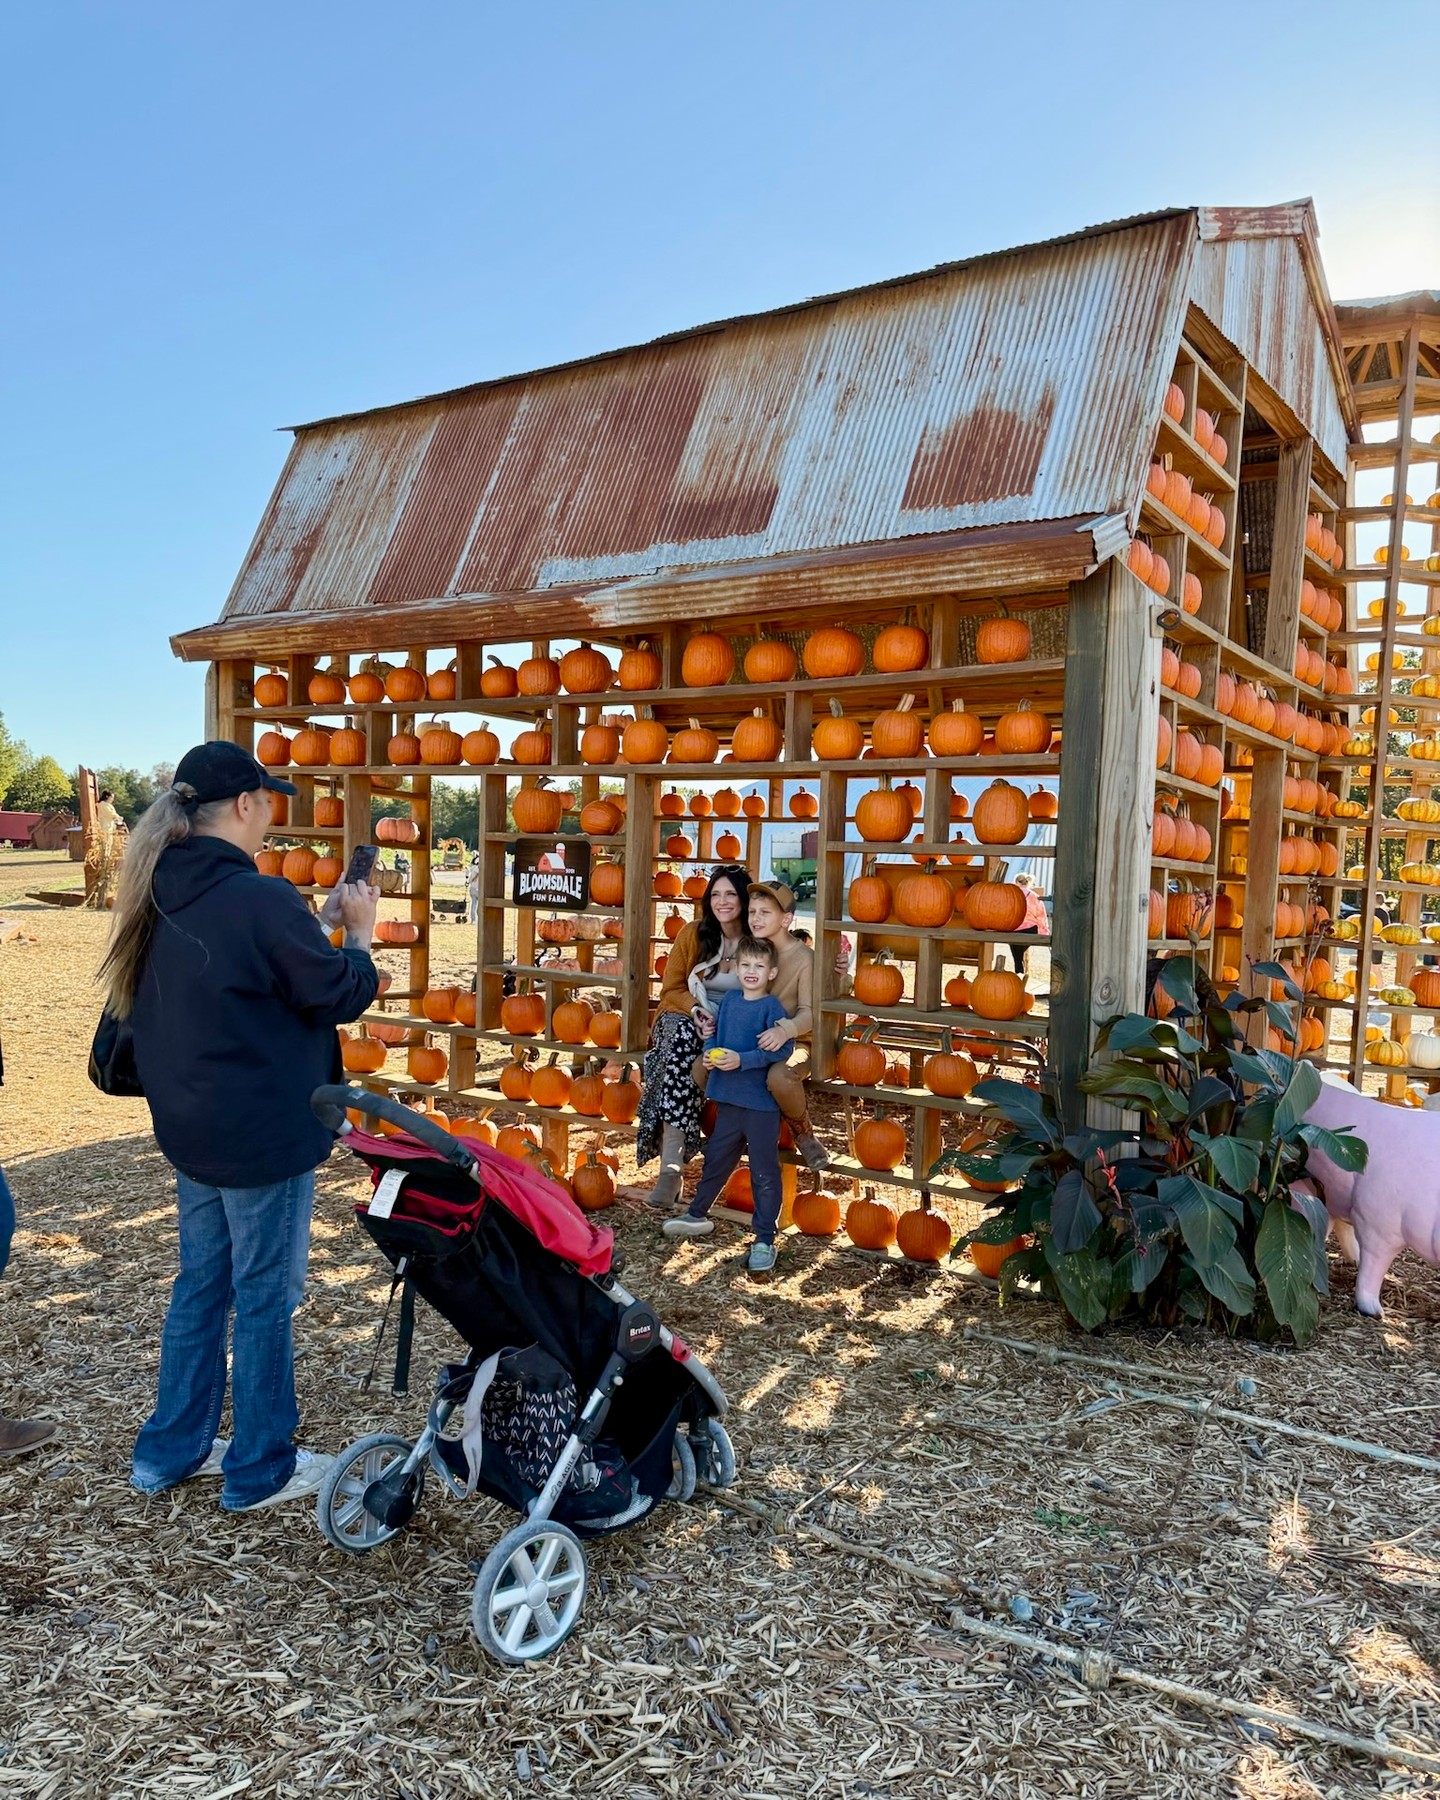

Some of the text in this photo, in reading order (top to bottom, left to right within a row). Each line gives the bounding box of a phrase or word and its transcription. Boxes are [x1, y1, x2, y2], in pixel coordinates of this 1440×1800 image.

[519, 872, 583, 900] BLOOMSDALE
[532, 893, 567, 903] FUN FARM
[629, 1325, 651, 1337] Britax
